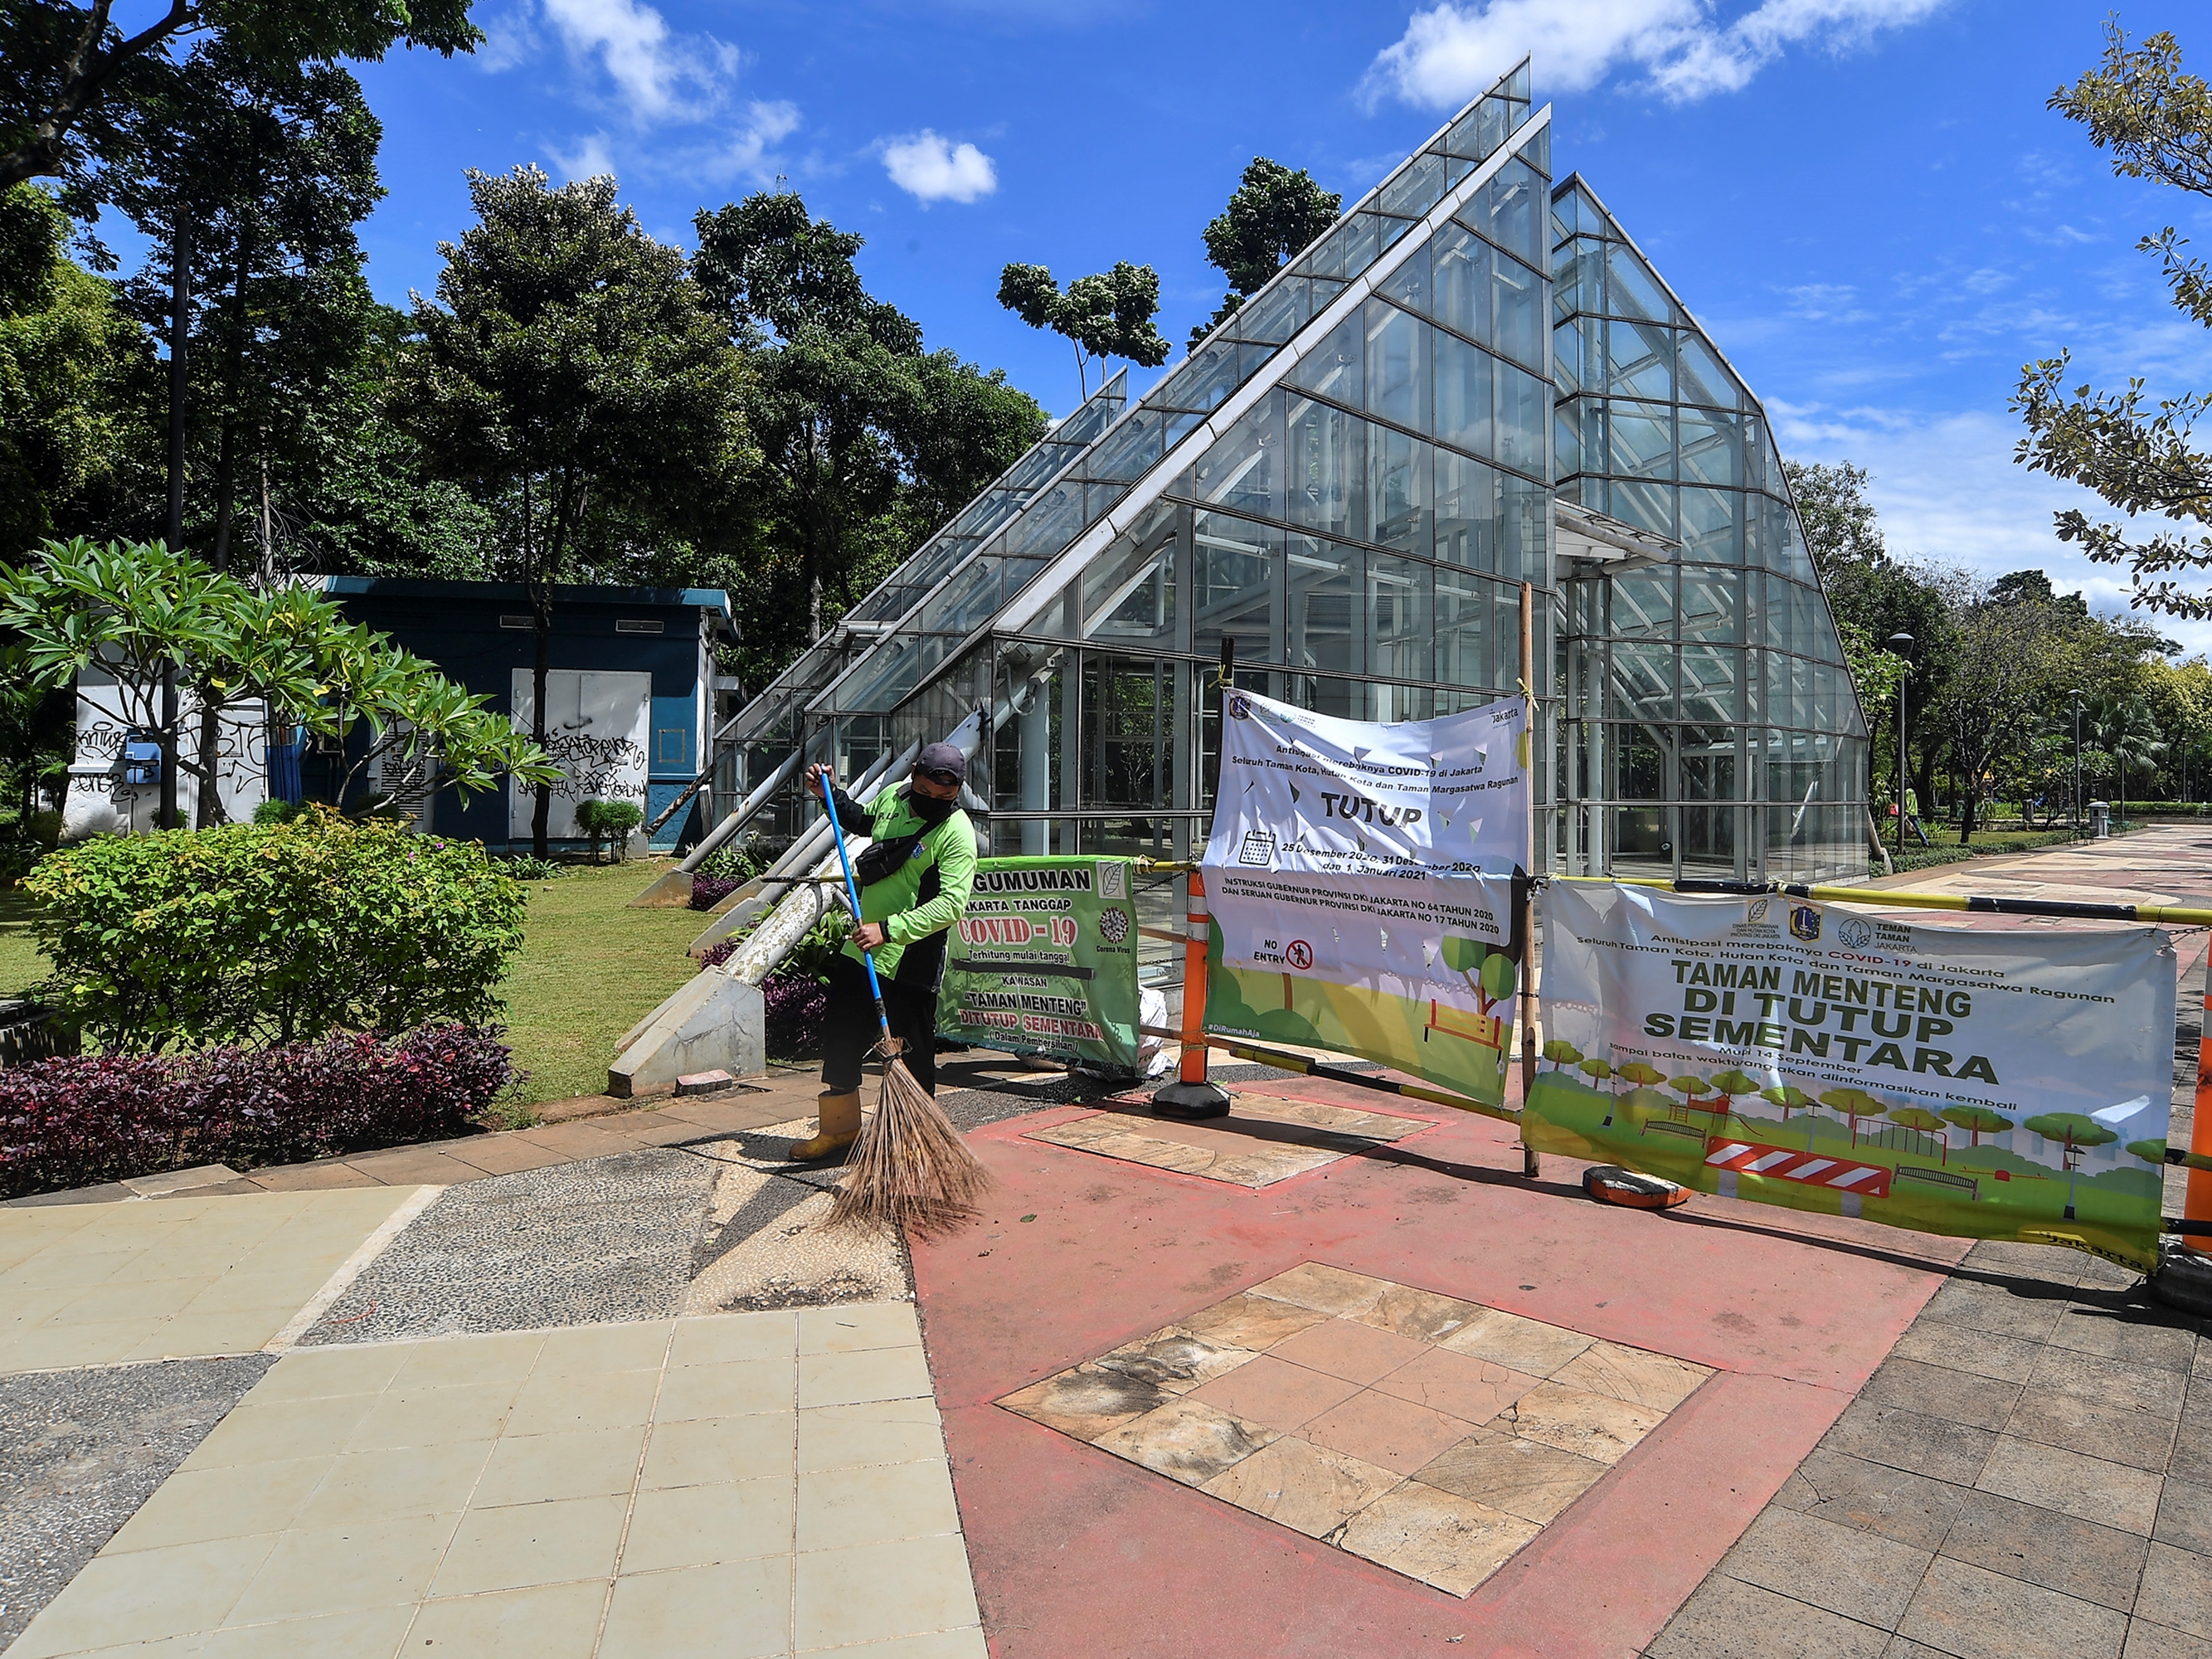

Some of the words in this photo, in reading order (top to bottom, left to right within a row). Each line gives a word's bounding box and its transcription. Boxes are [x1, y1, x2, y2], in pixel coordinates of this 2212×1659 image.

[1490, 708, 1519, 723] Jakarta
[1232, 756, 1263, 767] Seluruh
[1265, 759, 1294, 771] Taman
[1295, 763, 1320, 776] Kota,
[1349, 776, 1373, 787] Kota
[1374, 781, 1393, 791] dan
[1396, 783, 1429, 793] Taman
[1432, 783, 1485, 795] Margasatwa
[1486, 776, 1519, 790] Ragunan
[1388, 766, 1437, 778] COVID-19
[1438, 769, 1447, 777] di
[1451, 766, 1483, 777] Jakarta
[1320, 791, 1422, 829] TUTUP
[1281, 843, 1295, 852] 25
[1382, 855, 1394, 864] 31
[1395, 856, 1451, 871] Desber
[1451, 862, 1481, 873] 2020
[970, 870, 1091, 893] GUMUMAN
[1322, 862, 1341, 871] dan
[1346, 864, 1352, 872] 1
[1356, 864, 1398, 878] Januari
[1398, 869, 1427, 881] 2021
[1014, 898, 1072, 911] TANGGAP
[1222, 887, 1239, 896] DAN
[1241, 889, 1272, 900] SERUAN
[1274, 893, 1319, 907] GUBERNUR
[1320, 899, 1359, 912] PROVINSI
[1360, 904, 1376, 913] DKI
[1377, 907, 1417, 920] JAKARTA
[1417, 913, 1432, 922] NO
[1434, 915, 1446, 924] 17
[1446, 917, 1478, 930] TAHUN
[1479, 922, 1500, 935] 2020
[1224, 877, 1266, 888] INSTRUKSI
[1266, 882, 1310, 895] GUBERNUR
[1311, 888, 1351, 900] PROVINSI
[1353, 893, 1369, 902] DKI
[1369, 896, 1409, 908] JAKARTA
[1411, 900, 1426, 910] NO
[1427, 902, 1439, 912] 64
[1440, 904, 1472, 917] TAHUN
[1474, 908, 1494, 922] 2020
[1875, 932, 1910, 943] TAMAN
[1876, 923, 1911, 934] TEMAN
[1096, 945, 1116, 953] Corona
[1116, 946, 1130, 954] Virus
[1264, 939, 1278, 949] NO
[1874, 941, 1918, 953] JAKARTA
[968, 950, 1010, 961] Terhitung
[1013, 951, 1037, 960] mulai
[1039, 951, 1070, 963] tanggal
[1253, 951, 1286, 964] ENTRY
[1650, 934, 1721, 947] Antisipasi
[1726, 941, 1822, 957] merebaknya
[1828, 951, 1911, 967] COVID-19
[1937, 965, 2005, 978] Jakarta
[1002, 976, 1048, 988] KAWASAN
[1577, 937, 1617, 948] Seluruh
[1619, 942, 1670, 954] Taman
[1675, 947, 1714, 958] Kota,
[1719, 951, 1764, 961] Hutan
[1768, 954, 1804, 965] Kota
[1809, 961, 1840, 971] dan
[1845, 965, 1903, 979] Taman
[1909, 972, 2023, 993] Margasatwa
[2030, 986, 2115, 1004] Ragunan
[1671, 959, 1782, 990] TAMAN
[1792, 970, 1971, 1018] MENTENG
[960, 1009, 1018, 1029] DITUTUP
[1023, 1014, 1103, 1039] SEMENTARA
[1684, 988, 1735, 1015] DI
[1753, 992, 1954, 1044] TUTUP
[1208, 1024, 1260, 1038] #DiRumahAja
[1643, 1013, 2000, 1085] SEMENTARA
[1757, 1049, 1772, 1058] 14
[1777, 1053, 1863, 1073] September
[1609, 1043, 1648, 1056] sampai
[1652, 1051, 1692, 1060] batas
[1697, 1055, 1740, 1067] waktu
[1777, 1066, 1816, 1078] akan
[1821, 1073, 1940, 1098] diinformasikan
[1945, 1092, 2017, 1111] kembali
